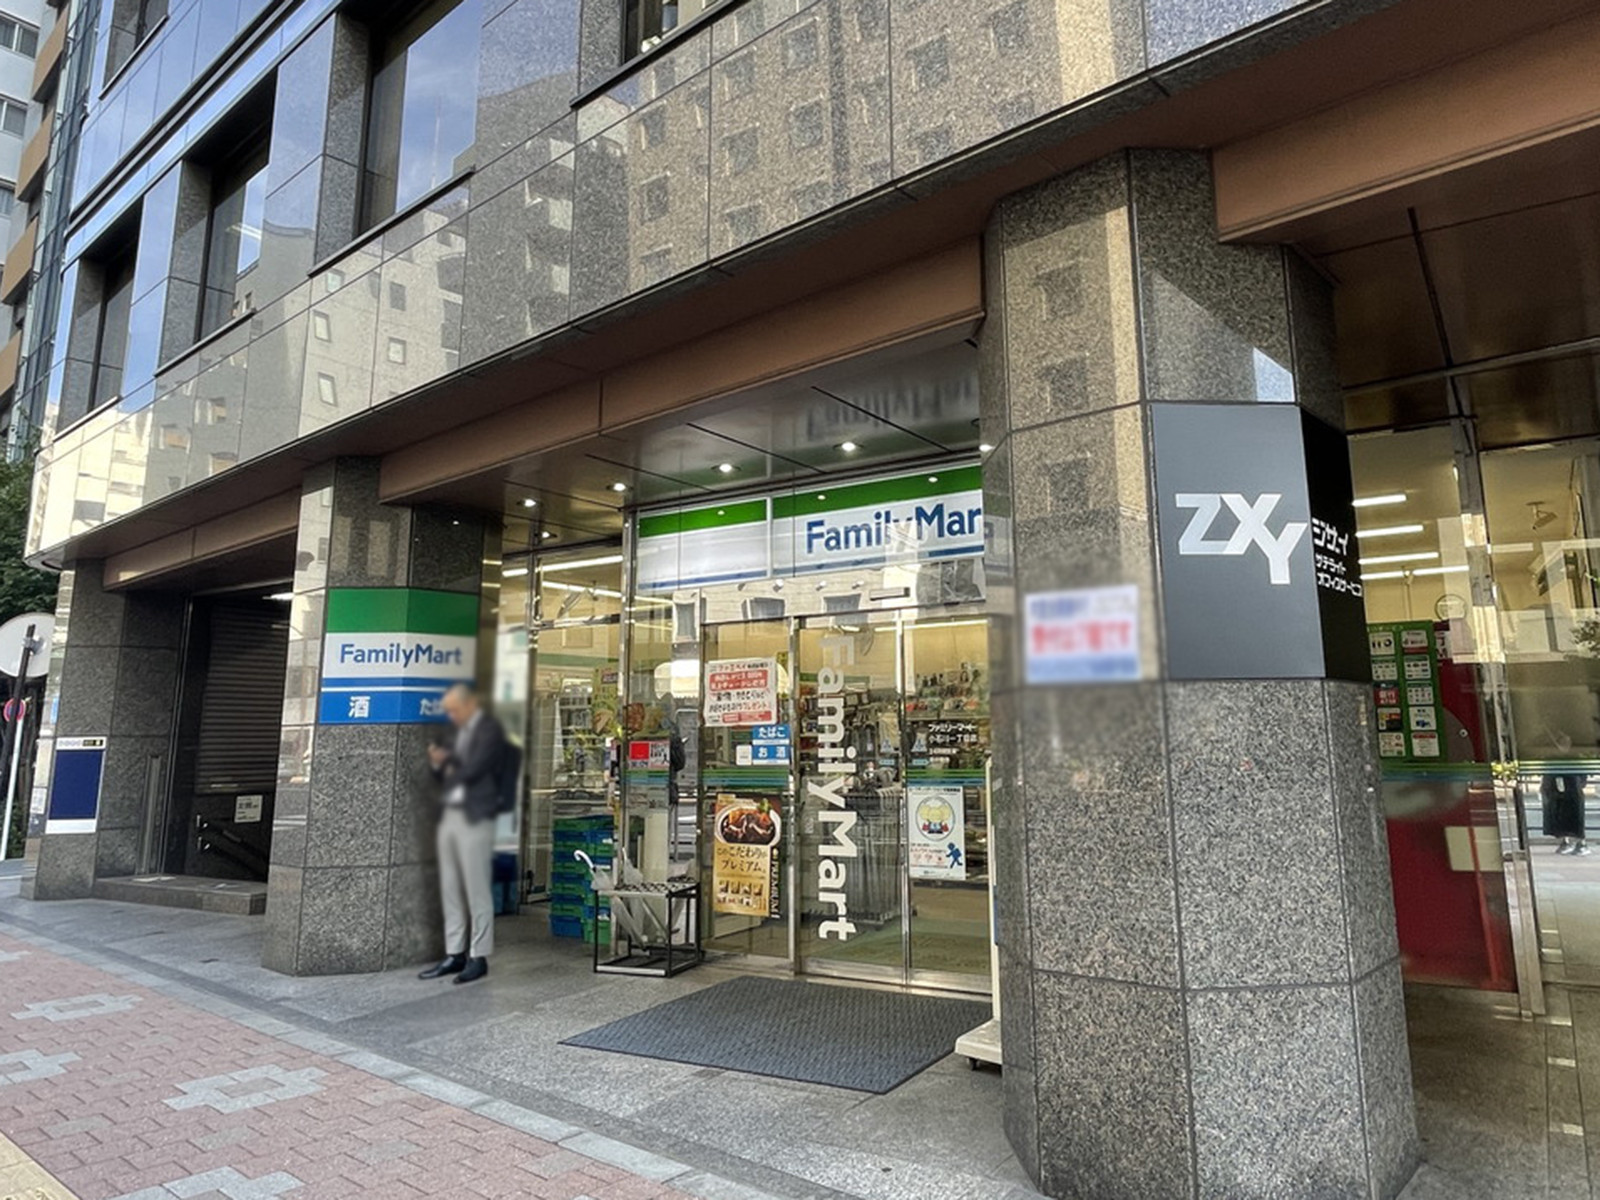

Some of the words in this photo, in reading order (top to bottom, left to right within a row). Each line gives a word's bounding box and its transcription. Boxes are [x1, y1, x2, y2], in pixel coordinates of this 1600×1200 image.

[1175, 493, 1308, 585] ZXY
[340, 643, 463, 668] FamilyMart
[348, 695, 371, 718] 酒
[758, 726, 786, 738] たばこ
[807, 635, 858, 942] FamilyMart
